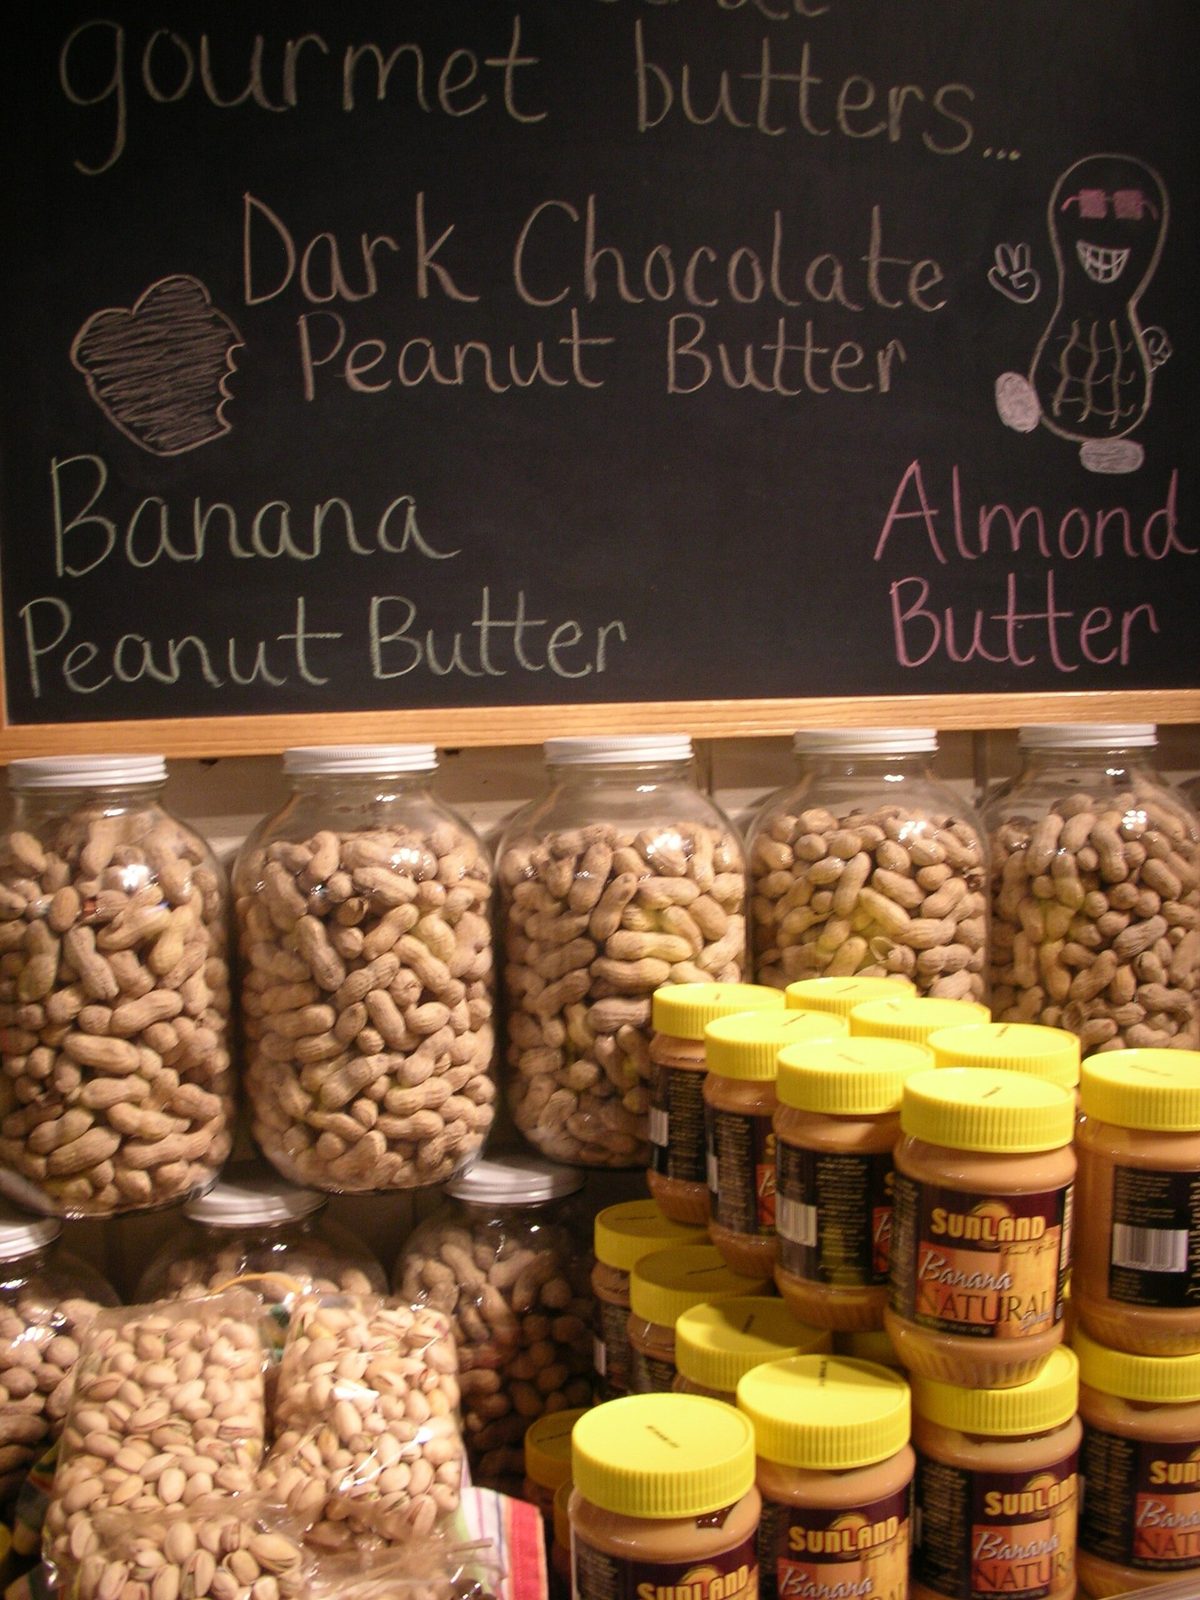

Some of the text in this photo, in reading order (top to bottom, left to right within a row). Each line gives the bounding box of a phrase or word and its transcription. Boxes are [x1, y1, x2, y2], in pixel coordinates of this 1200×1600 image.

[60, 15, 548, 175] gourmet
[242, 191, 948, 312] Dark Chocolate
[297, 307, 907, 402] Peanut Butter
[50, 454, 462, 578] Banana
[873, 459, 1199, 564] Almond
[18, 586, 627, 698] Peanut Butter
[889, 569, 1160, 672] Butter
[917, 1249, 1013, 1291] Banana
[778, 1566, 874, 1598] Banana
